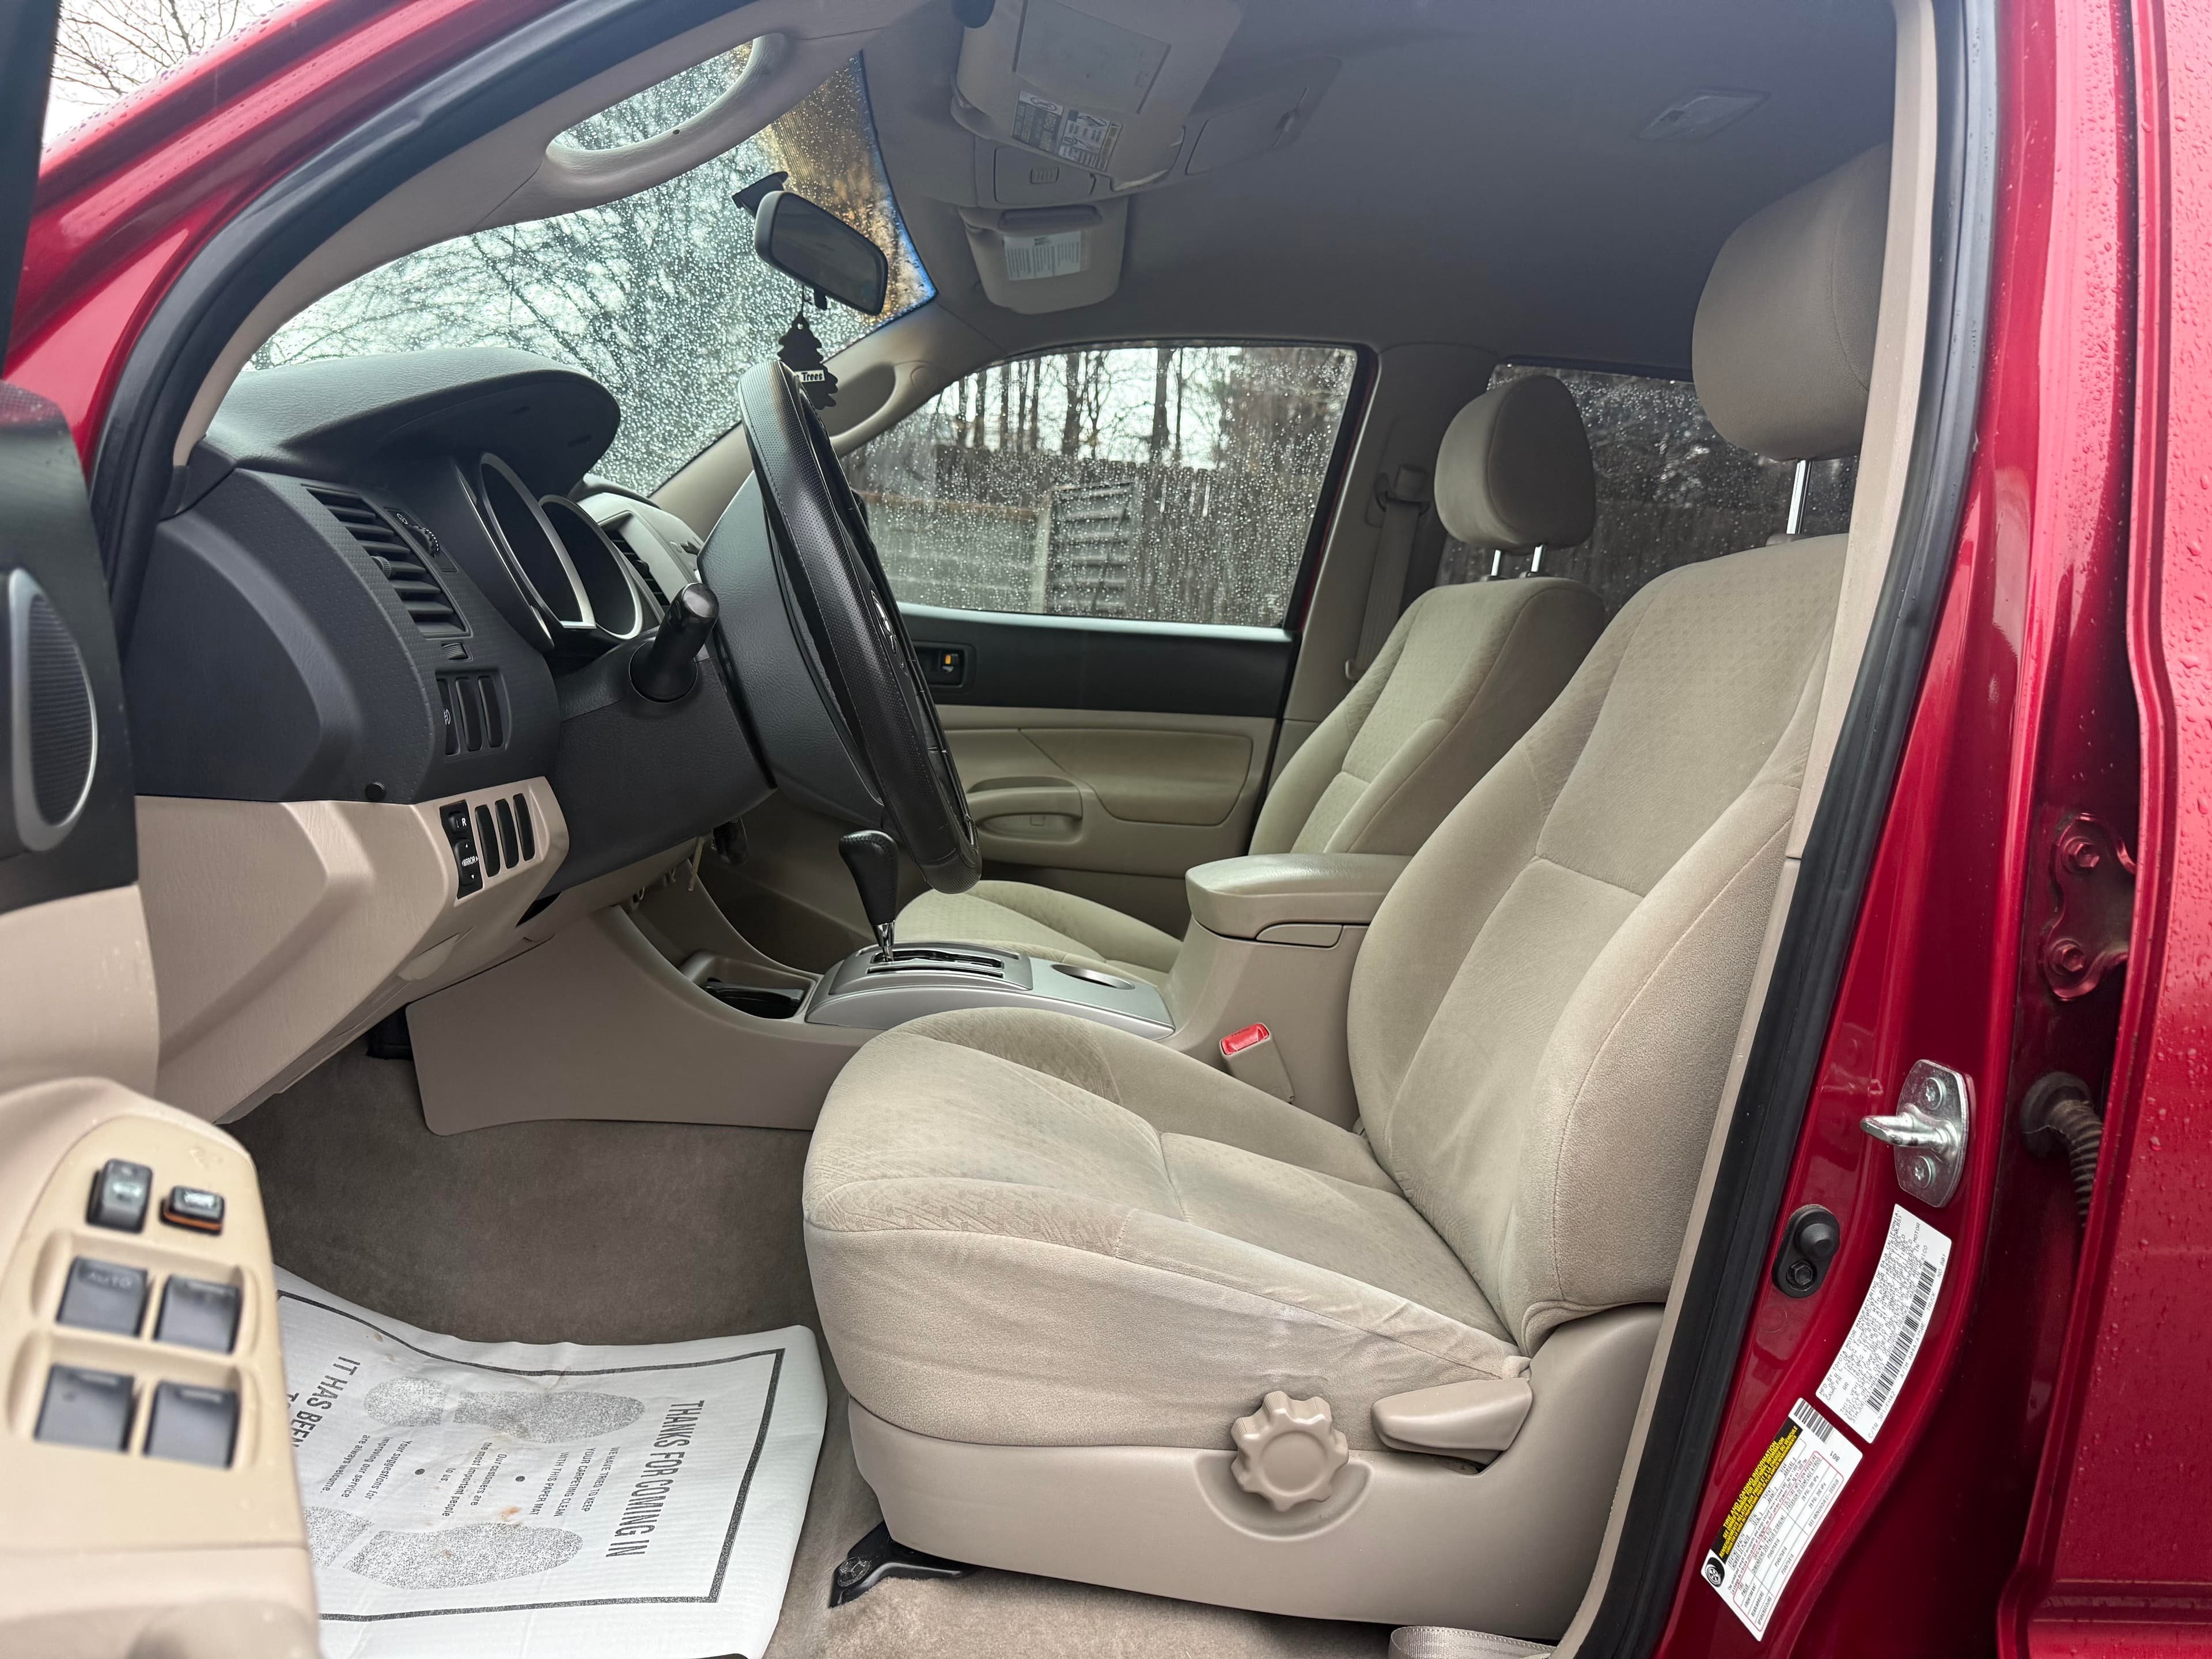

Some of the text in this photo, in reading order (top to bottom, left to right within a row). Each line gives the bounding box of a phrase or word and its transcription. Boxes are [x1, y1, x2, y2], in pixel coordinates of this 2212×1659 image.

[801, 372, 822, 381] Trees
[461, 817, 467, 827] R
[1926, 1291, 1936, 1312] TRUCK
[1844, 1330, 1857, 1349] MOTOR
[306, 1374, 348, 1410] HAS
[332, 1356, 361, 1376] IT
[343, 1445, 362, 1465] always
[358, 1434, 370, 1445] are
[341, 1437, 393, 1498] improving our service
[365, 1440, 412, 1499] Your suggestions for
[442, 1442, 493, 1517] the most important people
[470, 1454, 507, 1506] Our customers are
[529, 1452, 570, 1516] WITH THIS PAPER MAT
[553, 1448, 596, 1517] YOUR CARPETING CLEAN
[581, 1446, 620, 1512] WE HAVE TRIED TO KEEP
[605, 1400, 704, 1557] THANKS FOR COMING IN
[1730, 1501, 1739, 1516] AND
[1737, 1475, 1754, 1504] LOADING
[1751, 1438, 1777, 1479] INFORMATION
